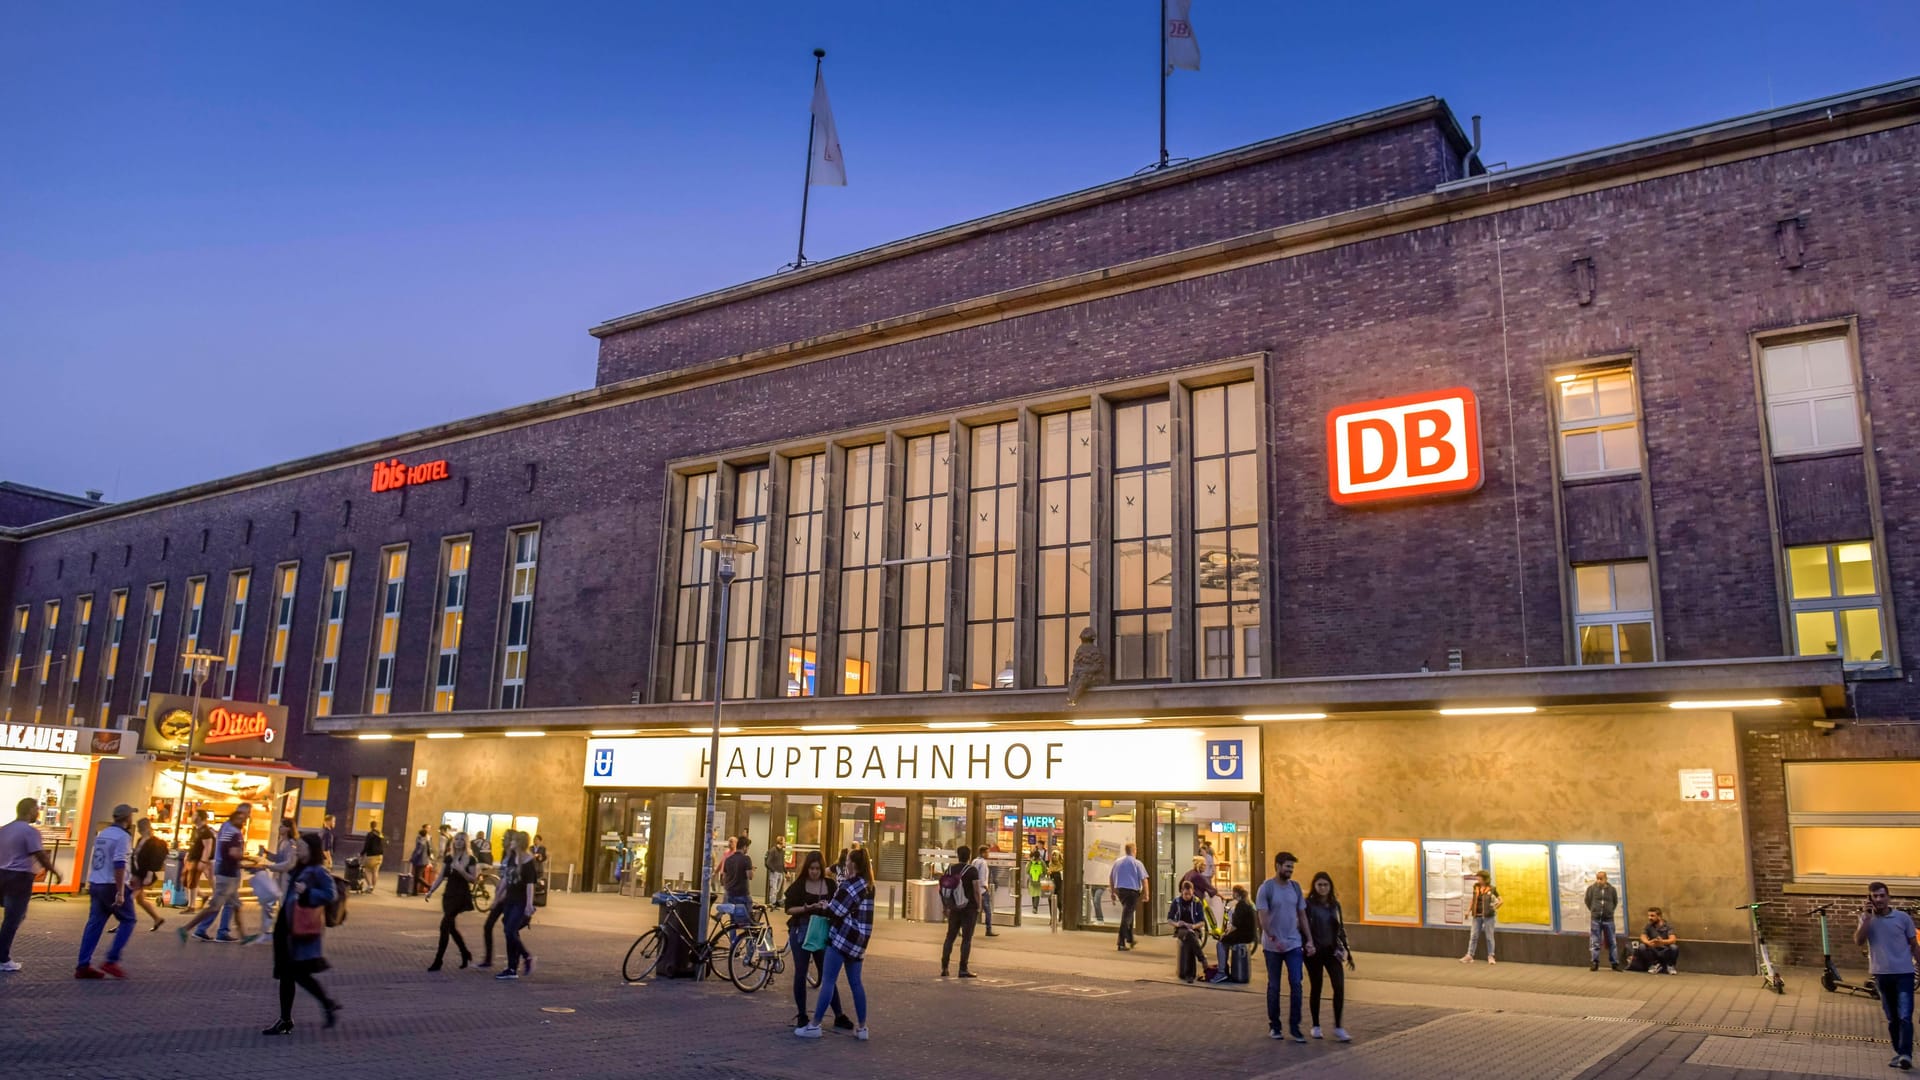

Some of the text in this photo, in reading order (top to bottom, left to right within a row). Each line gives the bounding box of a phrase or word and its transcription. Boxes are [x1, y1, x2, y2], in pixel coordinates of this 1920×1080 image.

[1347, 409, 1456, 485] DB
[371, 459, 449, 493] ibis HOTEL
[209, 707, 268, 737] Ditsch
[700, 743, 1063, 780] HAUPTBAHNHOF
